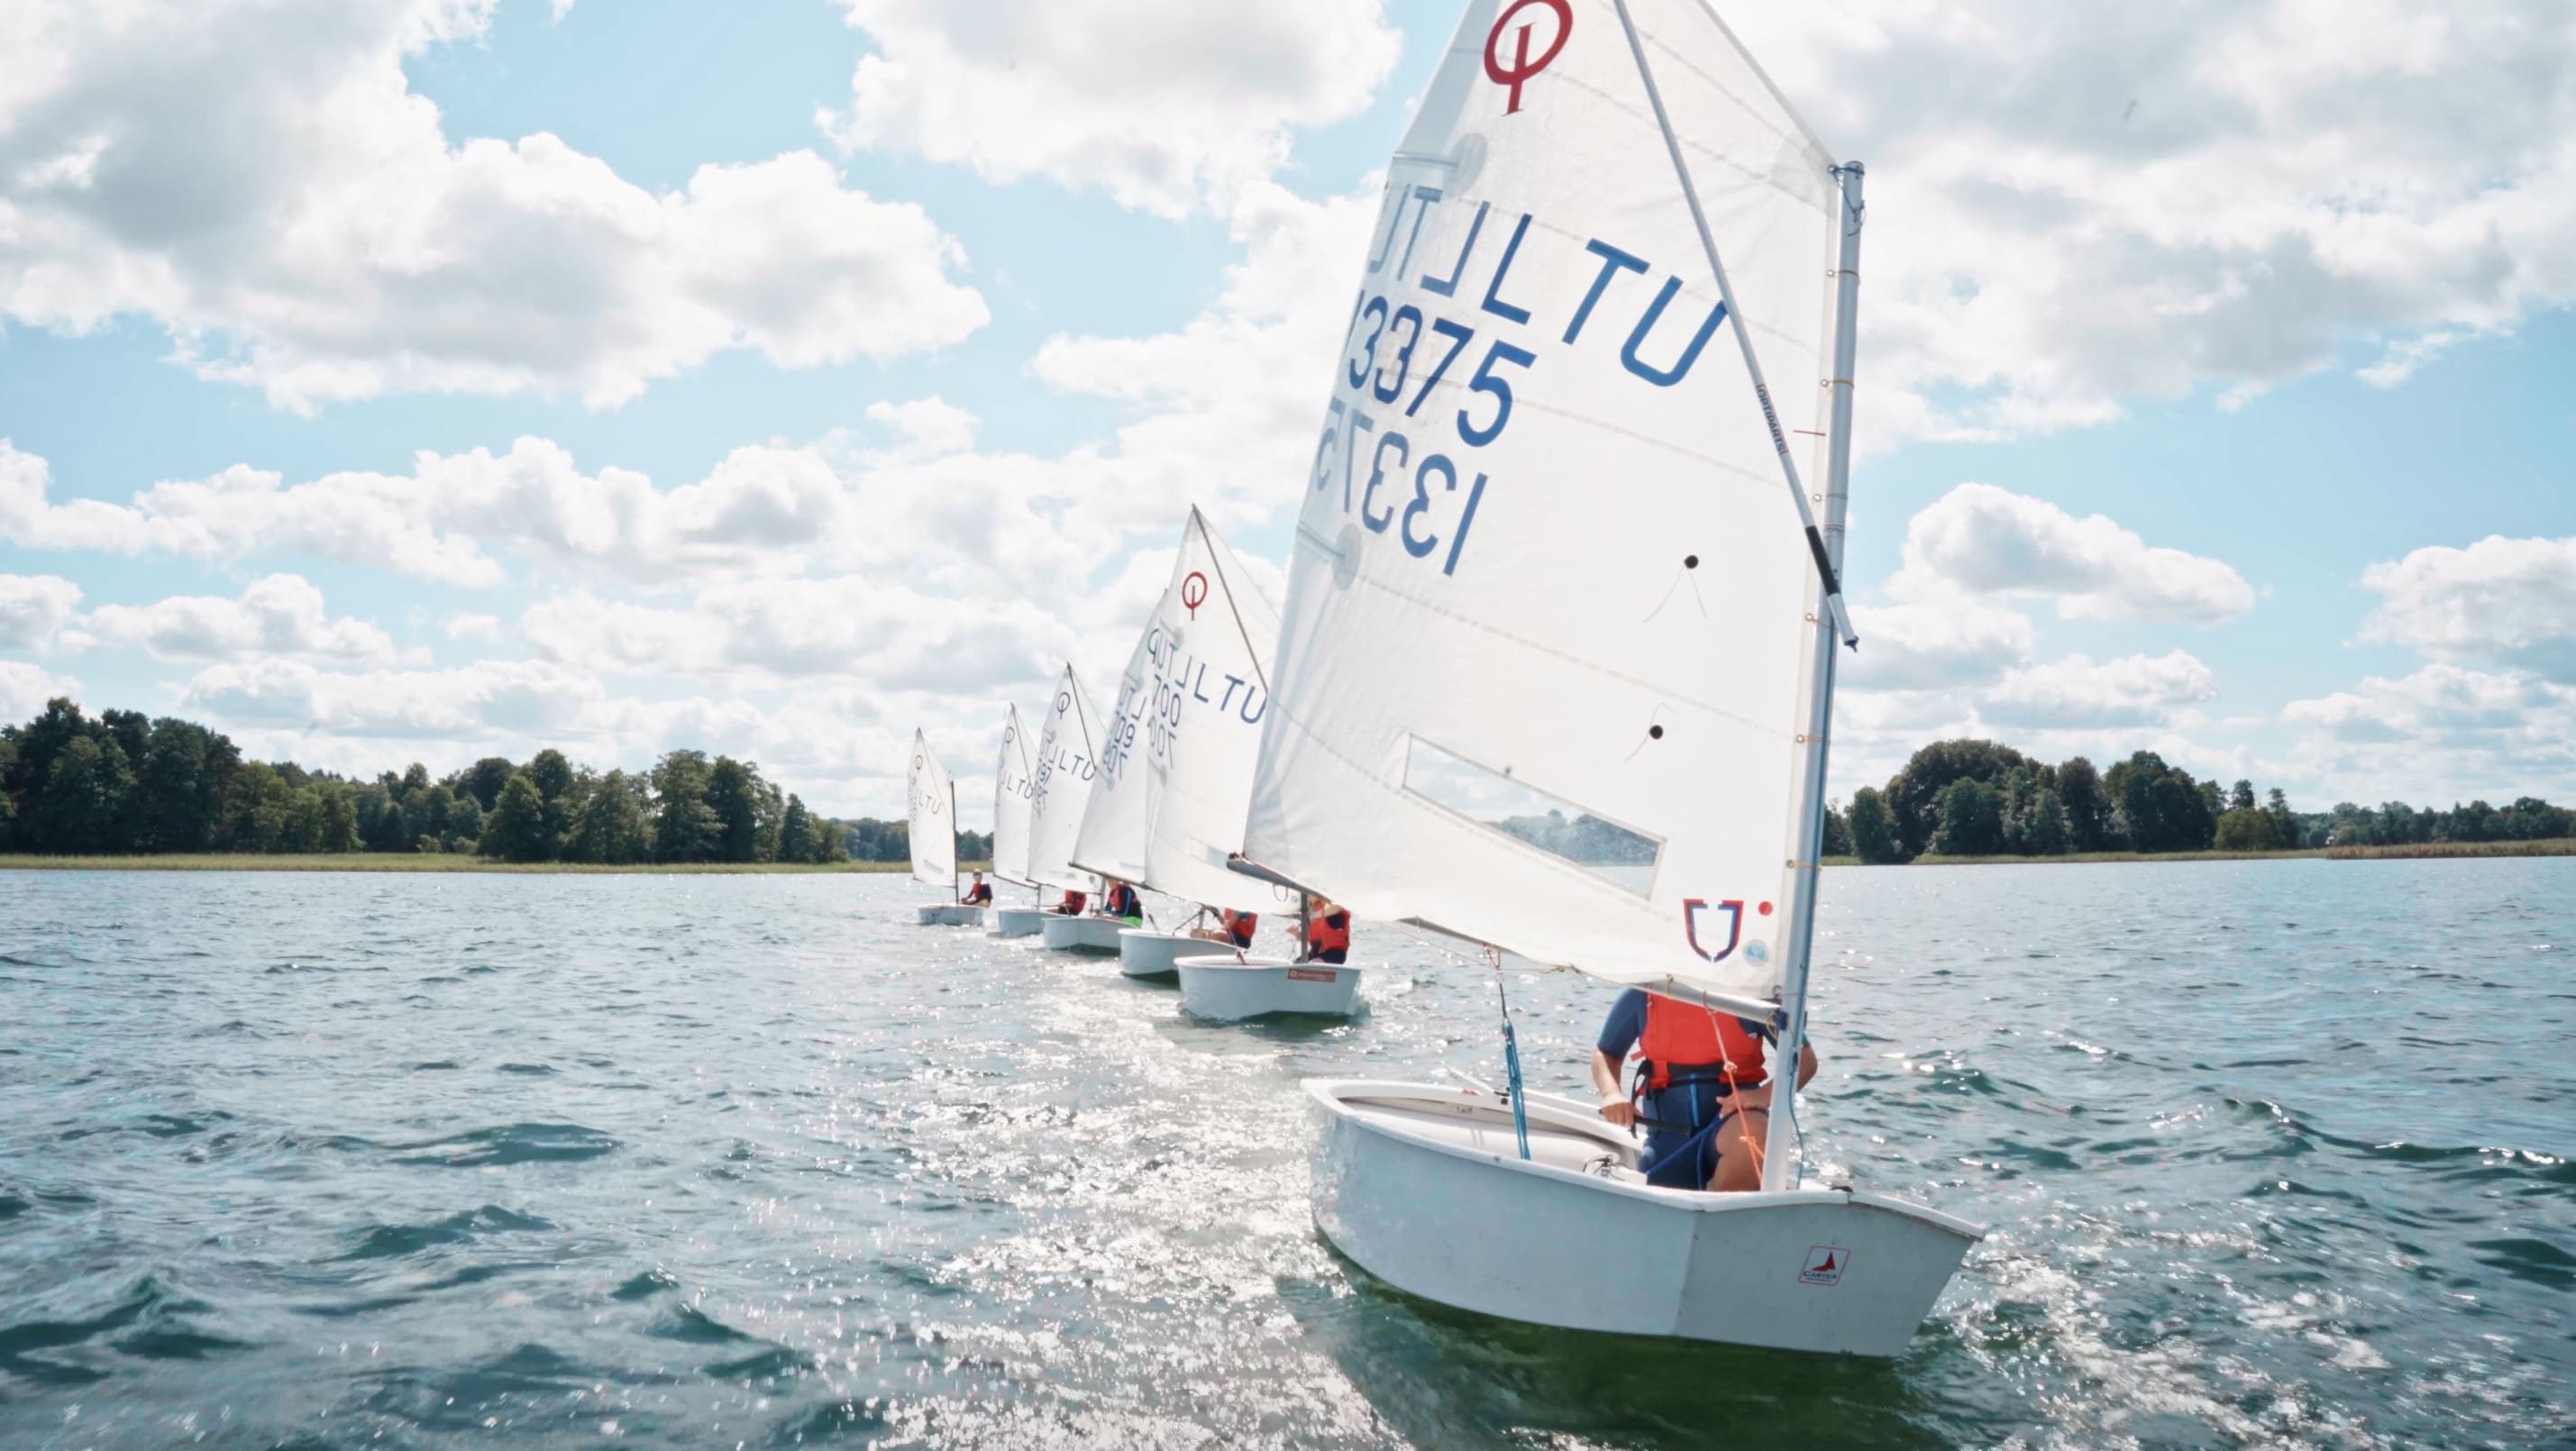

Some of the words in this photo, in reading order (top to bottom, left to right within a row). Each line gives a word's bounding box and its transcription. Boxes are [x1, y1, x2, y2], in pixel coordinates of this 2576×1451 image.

[1481, 214, 1728, 388] LTU
[1153, 673, 1181, 728] 700
[1194, 662, 1267, 724] LTU
[1059, 749, 1095, 781] LTU
[918, 790, 942, 815] LTU
